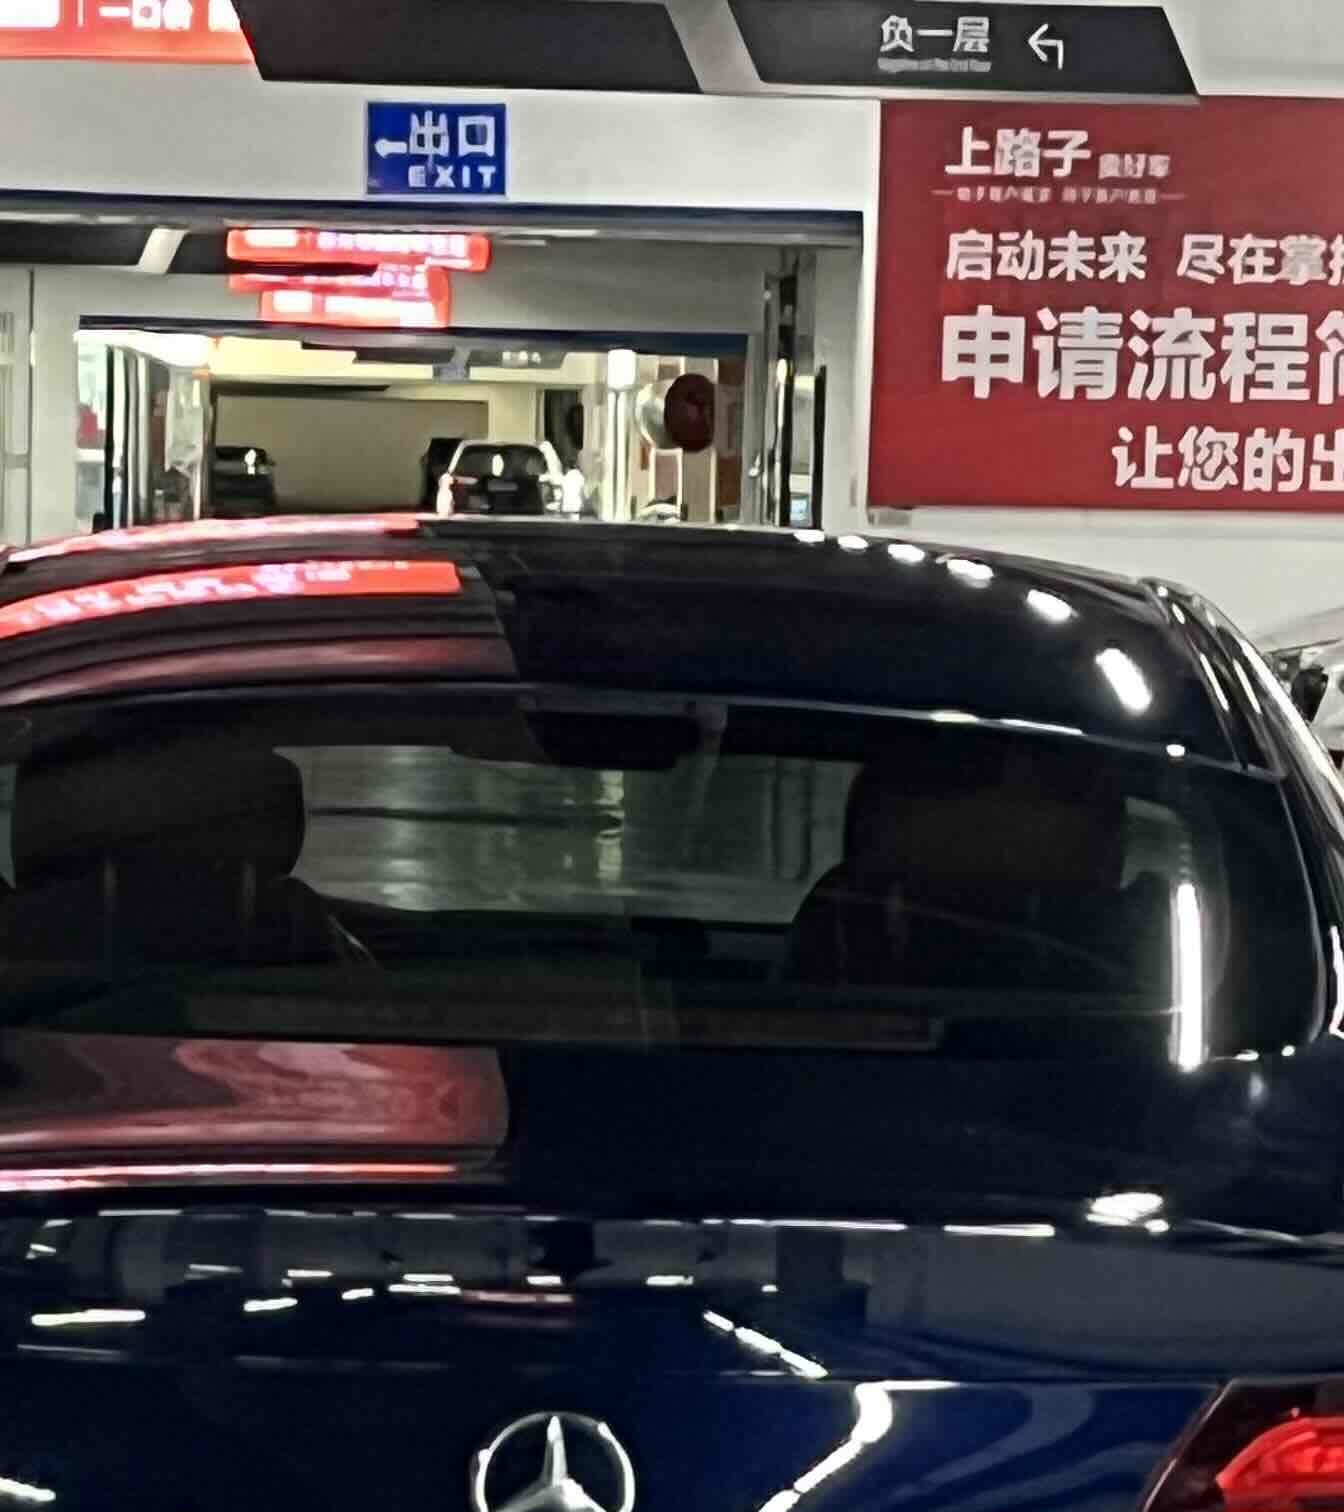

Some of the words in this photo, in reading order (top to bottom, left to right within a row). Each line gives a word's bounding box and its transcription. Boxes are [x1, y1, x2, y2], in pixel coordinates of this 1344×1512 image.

[880, 15, 990, 52] 负一层
[408, 110, 496, 157] 出口
[944, 126, 1092, 177] 上路子
[408, 165, 496, 188] EXIT
[945, 229, 1147, 283] 启动未来
